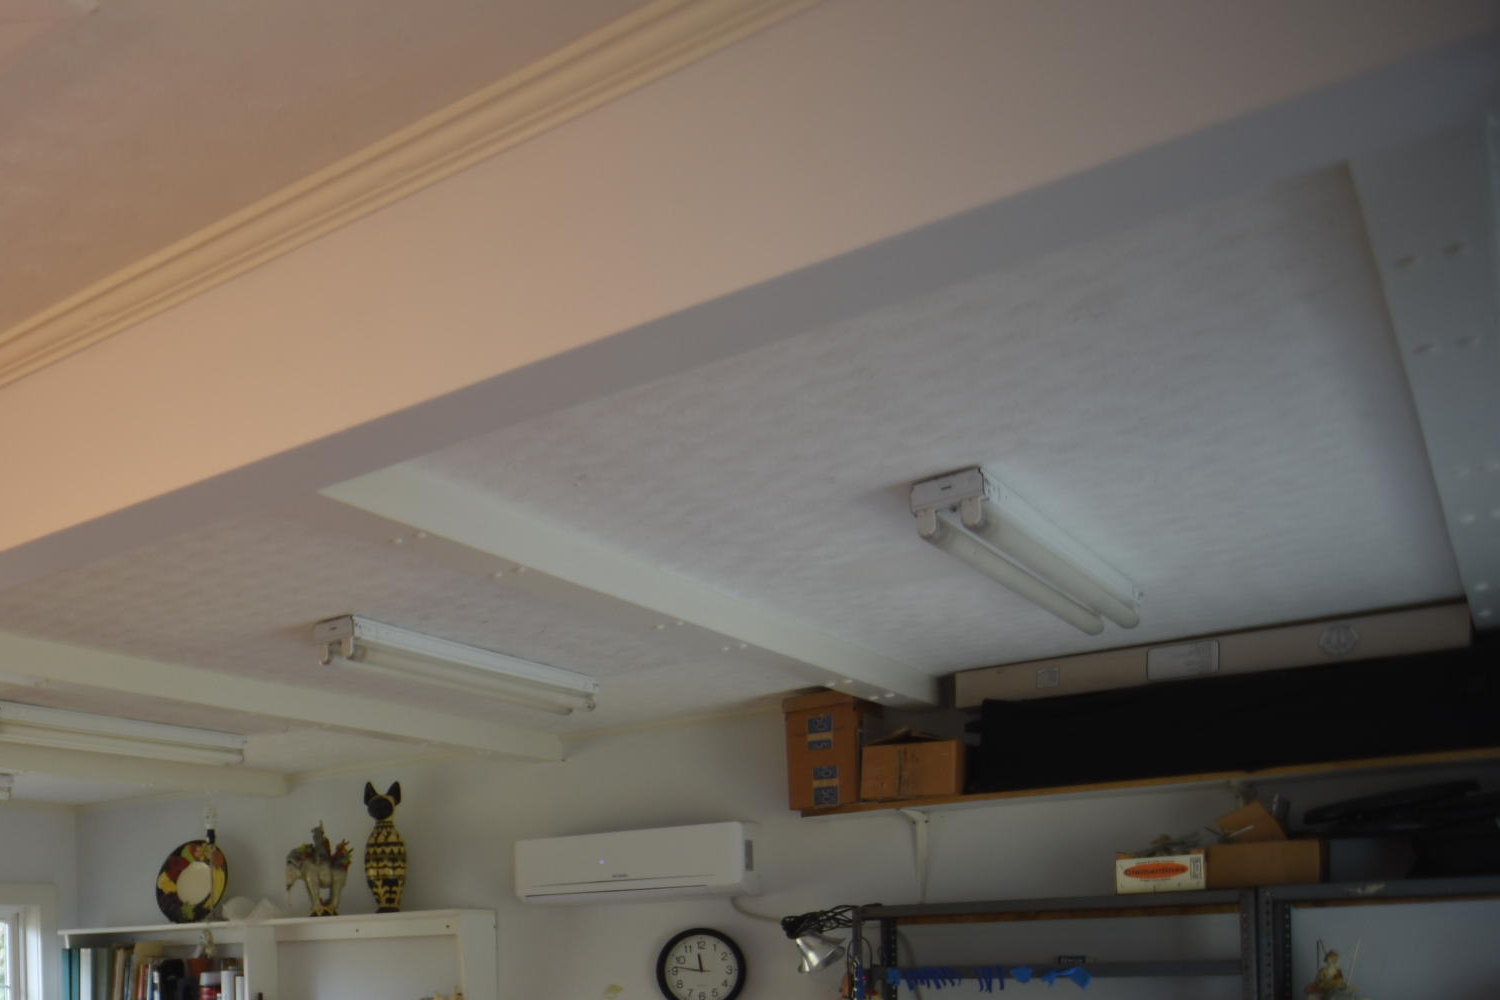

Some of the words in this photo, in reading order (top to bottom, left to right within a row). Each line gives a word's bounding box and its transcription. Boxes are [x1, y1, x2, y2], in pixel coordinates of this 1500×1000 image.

[684, 945, 692, 953] 11
[696, 941, 706, 950] 12
[675, 956, 686, 965] 10
[721, 952, 728, 961] 2
[671, 966, 678, 976] 9
[725, 966, 733, 975] 3
[676, 980, 684, 989] 8
[721, 979, 728, 988] 4
[687, 989, 693, 998] 7
[699, 992, 706, 1000] 6
[712, 988, 718, 998] 5
